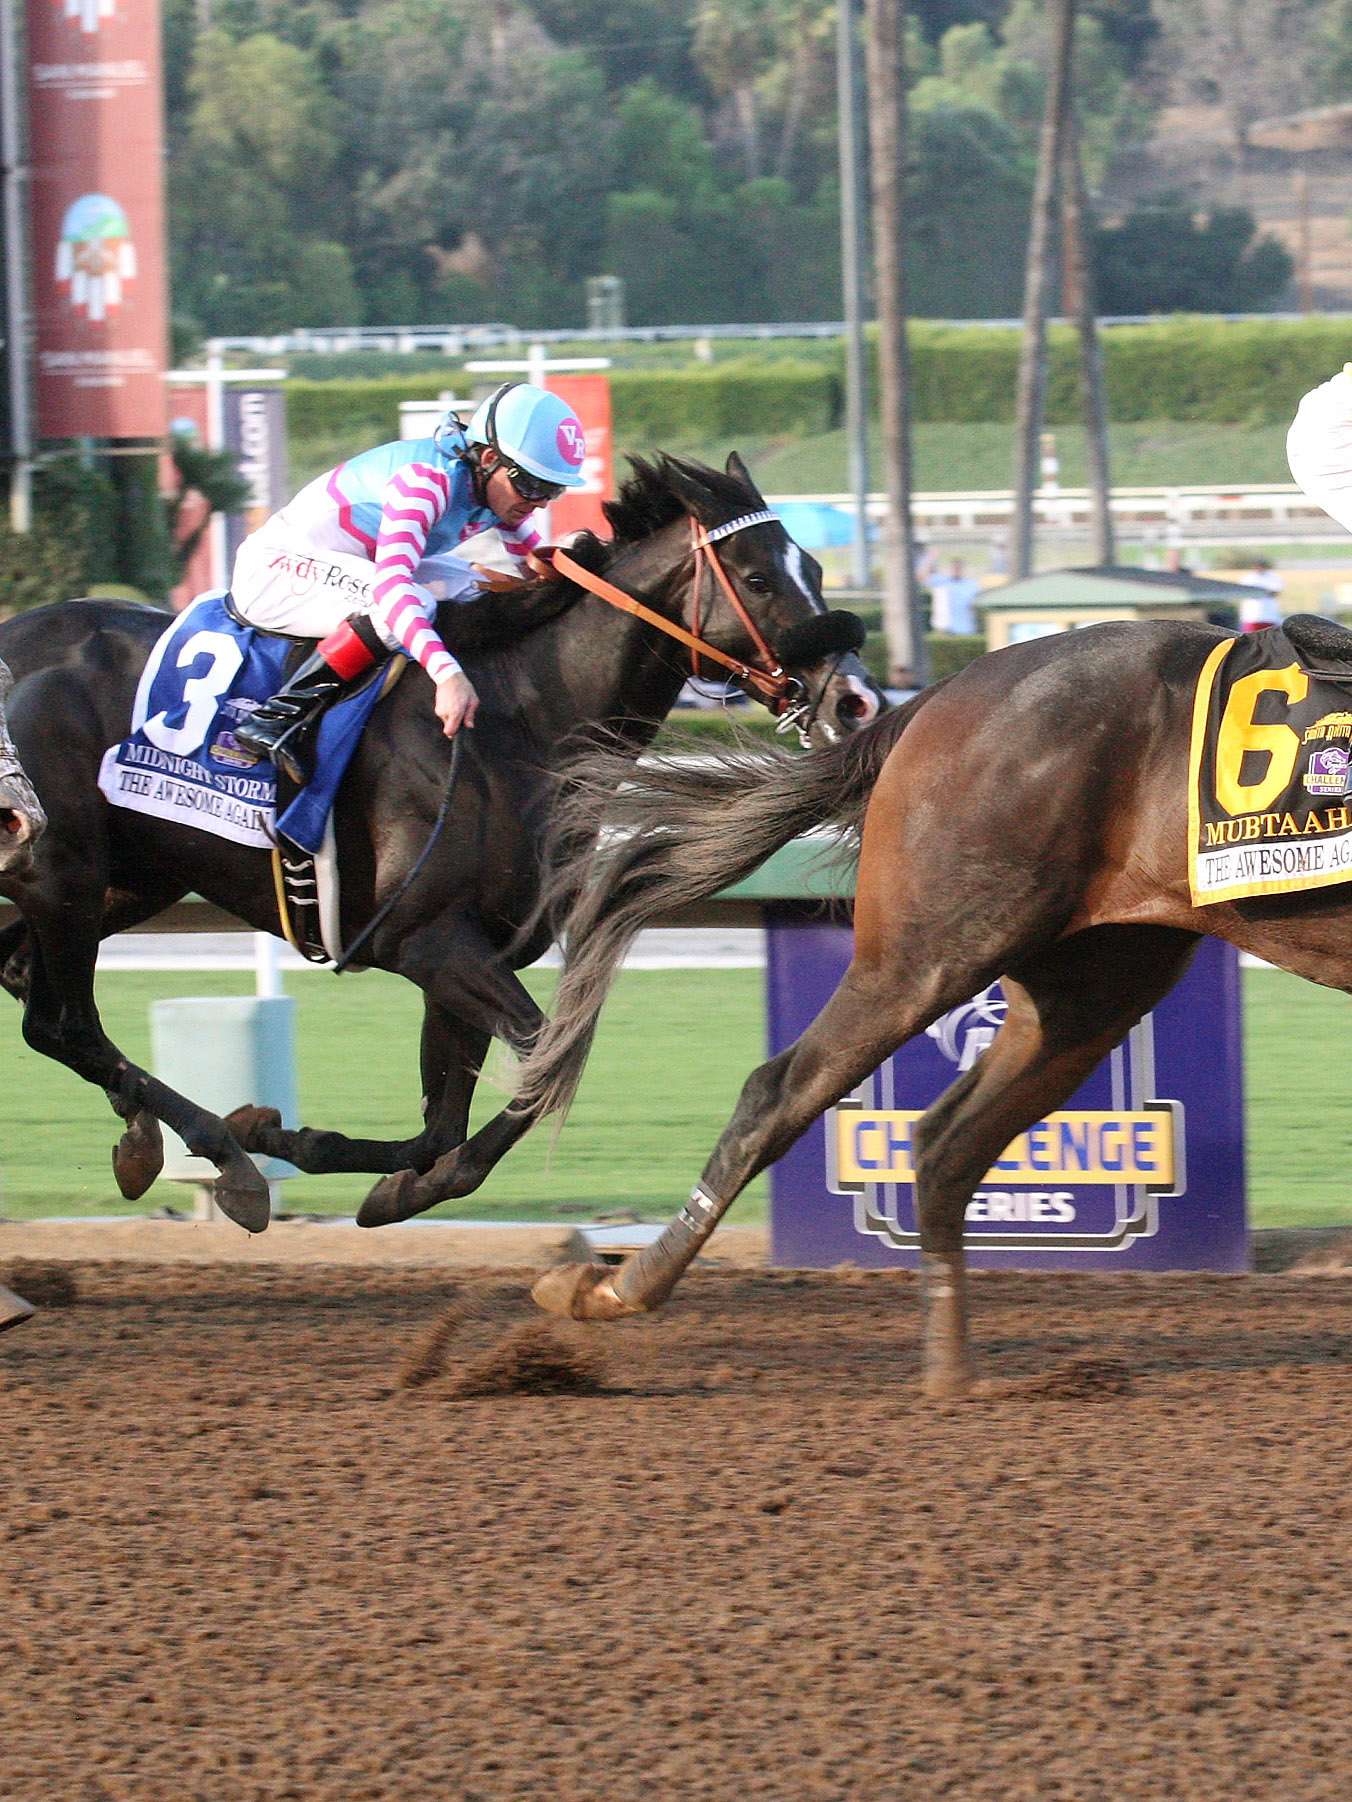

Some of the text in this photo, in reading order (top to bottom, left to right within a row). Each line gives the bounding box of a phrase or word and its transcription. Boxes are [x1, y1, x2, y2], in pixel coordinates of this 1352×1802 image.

[143, 630, 244, 756] 3
[1215, 661, 1309, 816] 6
[120, 770, 152, 796] THE
[153, 779, 223, 817] AWESOME
[214, 774, 277, 803] STORM
[1206, 854, 1231, 884] THE
[1235, 845, 1324, 879] AWESOME
[855, 1121, 1157, 1172] CHENGE
[964, 1192, 1076, 1223] ERIES
